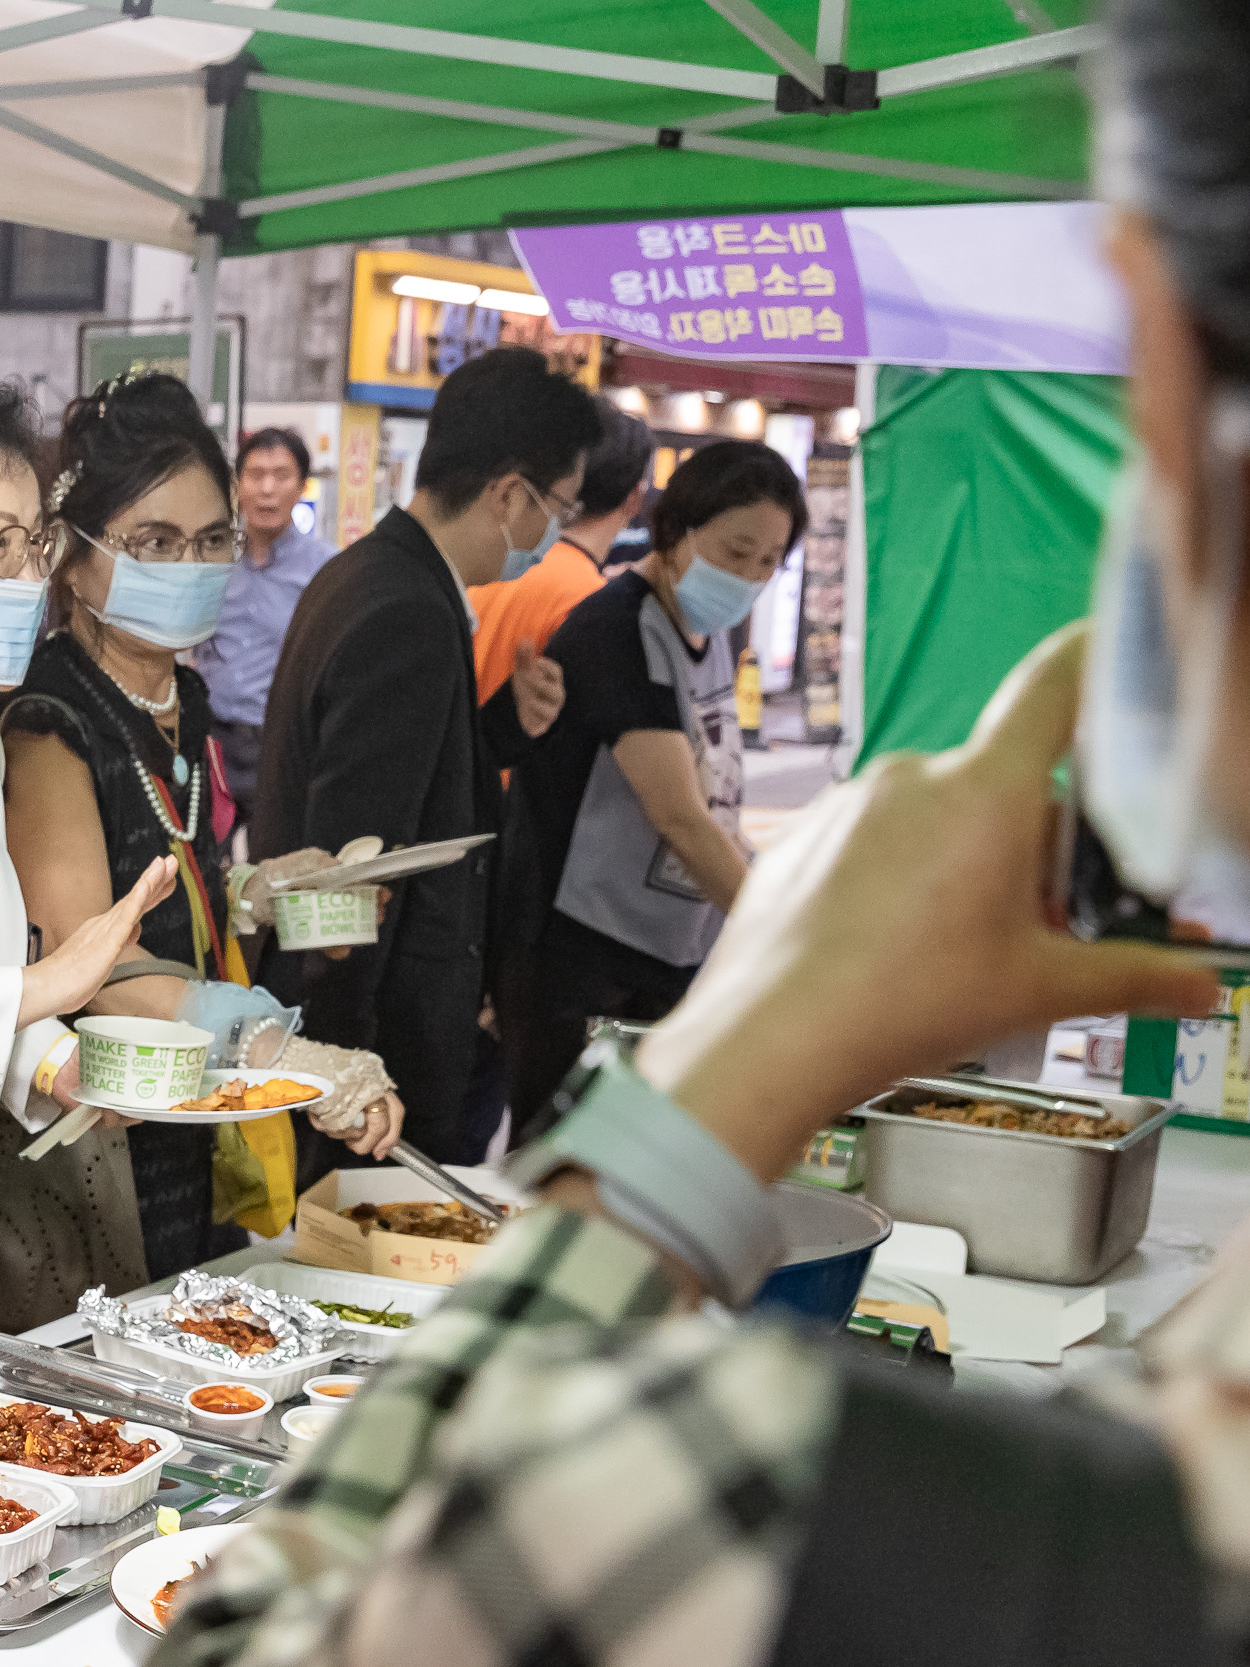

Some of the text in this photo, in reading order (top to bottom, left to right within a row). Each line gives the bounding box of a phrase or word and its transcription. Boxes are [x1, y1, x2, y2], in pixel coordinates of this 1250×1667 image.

[85, 1035, 127, 1057] MAKE
[132, 1057, 167, 1069] GREEN
[85, 1073, 126, 1095] PLACE
